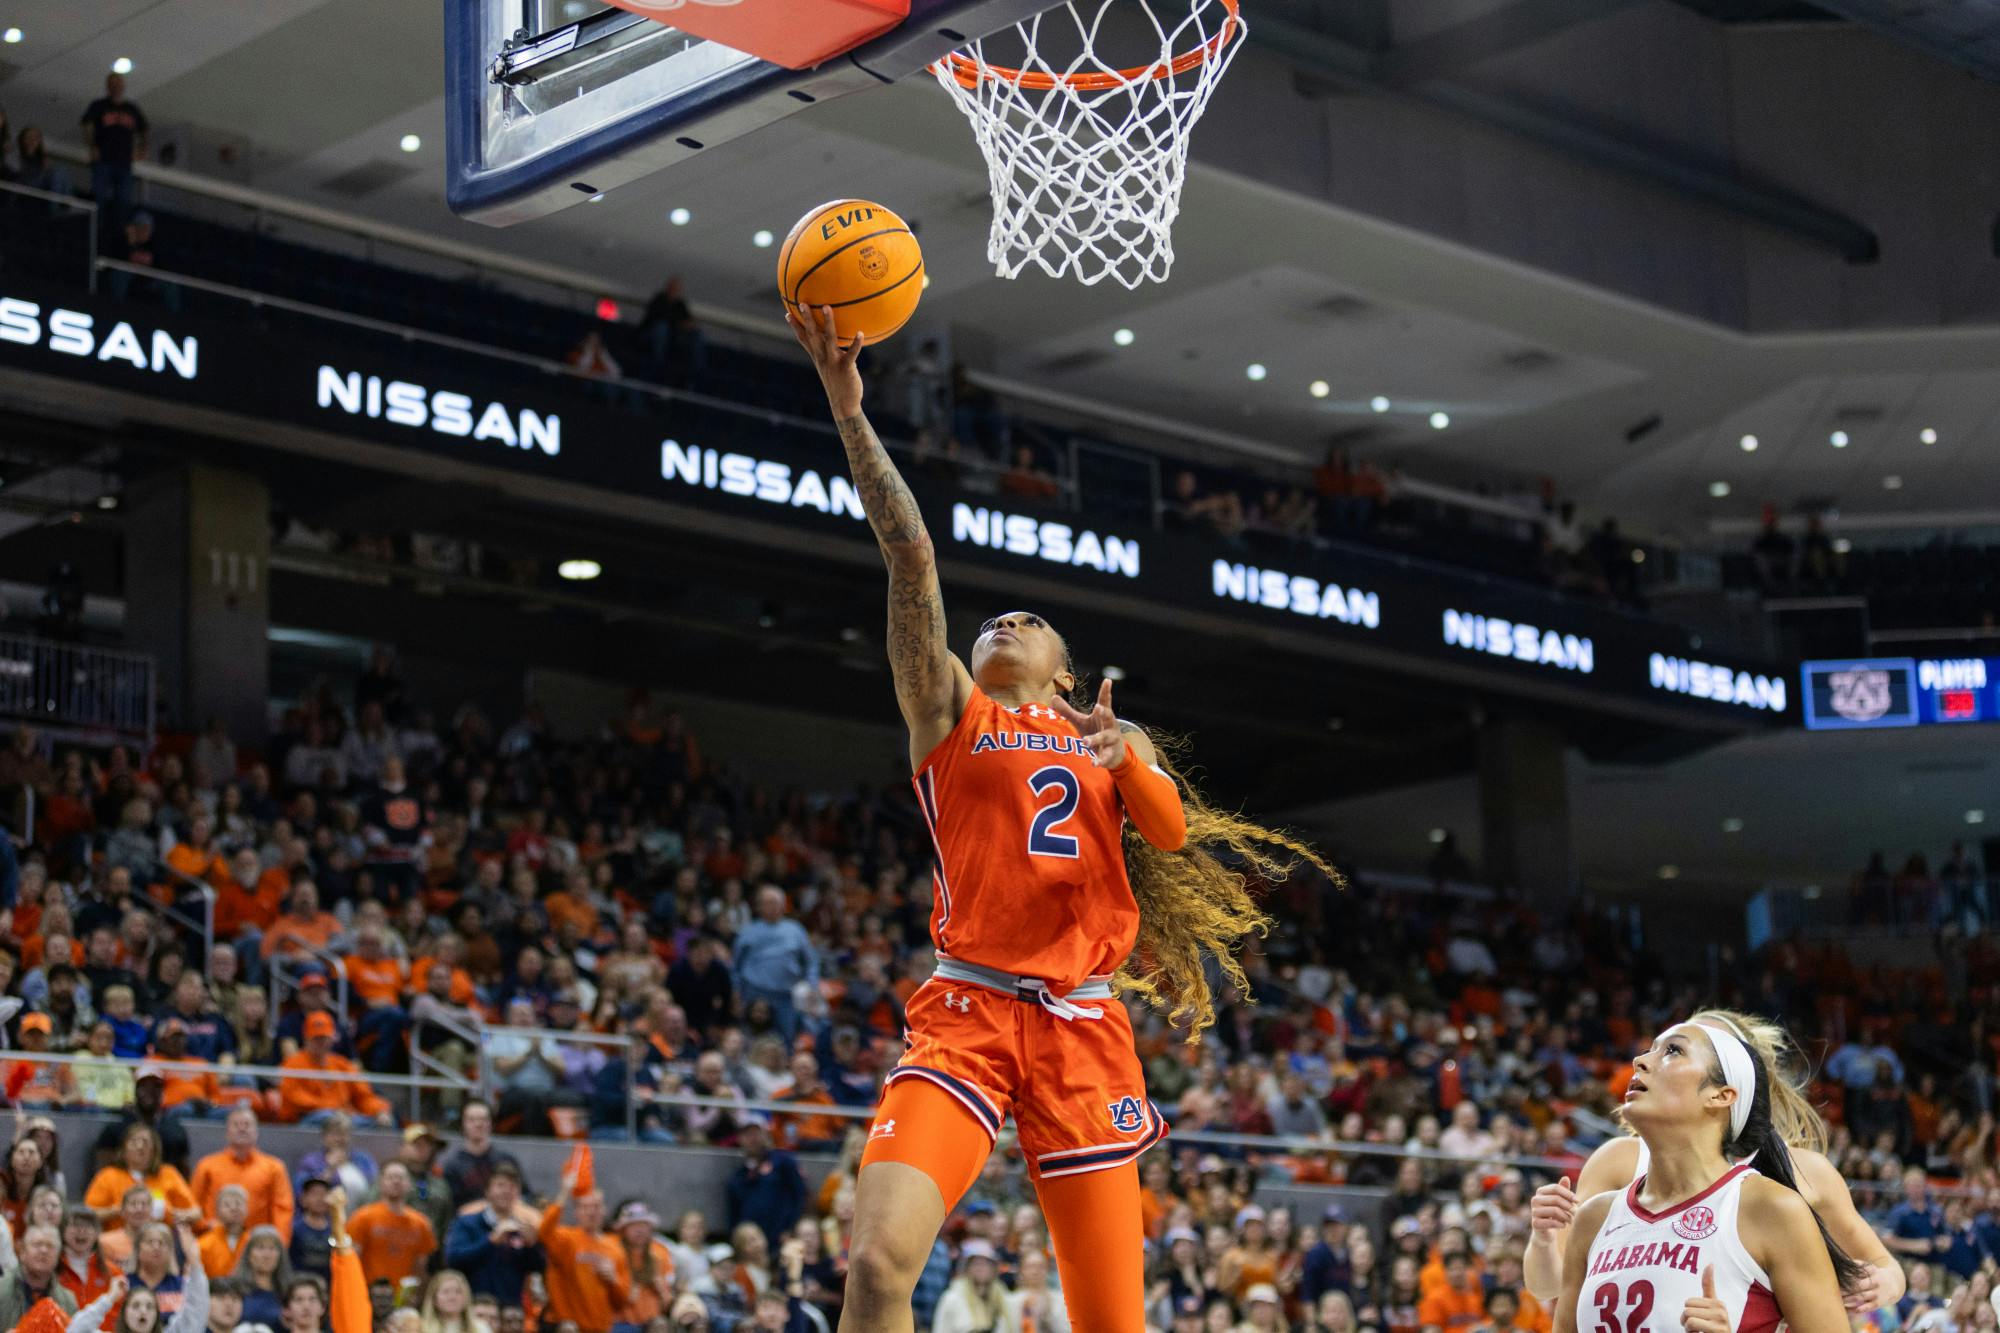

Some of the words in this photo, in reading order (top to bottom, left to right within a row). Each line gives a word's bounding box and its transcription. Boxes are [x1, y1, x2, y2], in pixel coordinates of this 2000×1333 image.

[821, 208, 873, 240] EVO
[317, 365, 561, 456] NISSAN
[952, 502, 1140, 578] NISSAN
[1212, 558, 1380, 629] NISSAN
[1442, 608, 1594, 674] NISSAN
[1649, 652, 1787, 712] NISSAN
[971, 731, 1097, 759] AUBUR
[1027, 765, 1080, 859] 2
[1588, 1241, 1700, 1278] ALABAMA
[1593, 1279, 1655, 1333] 32
